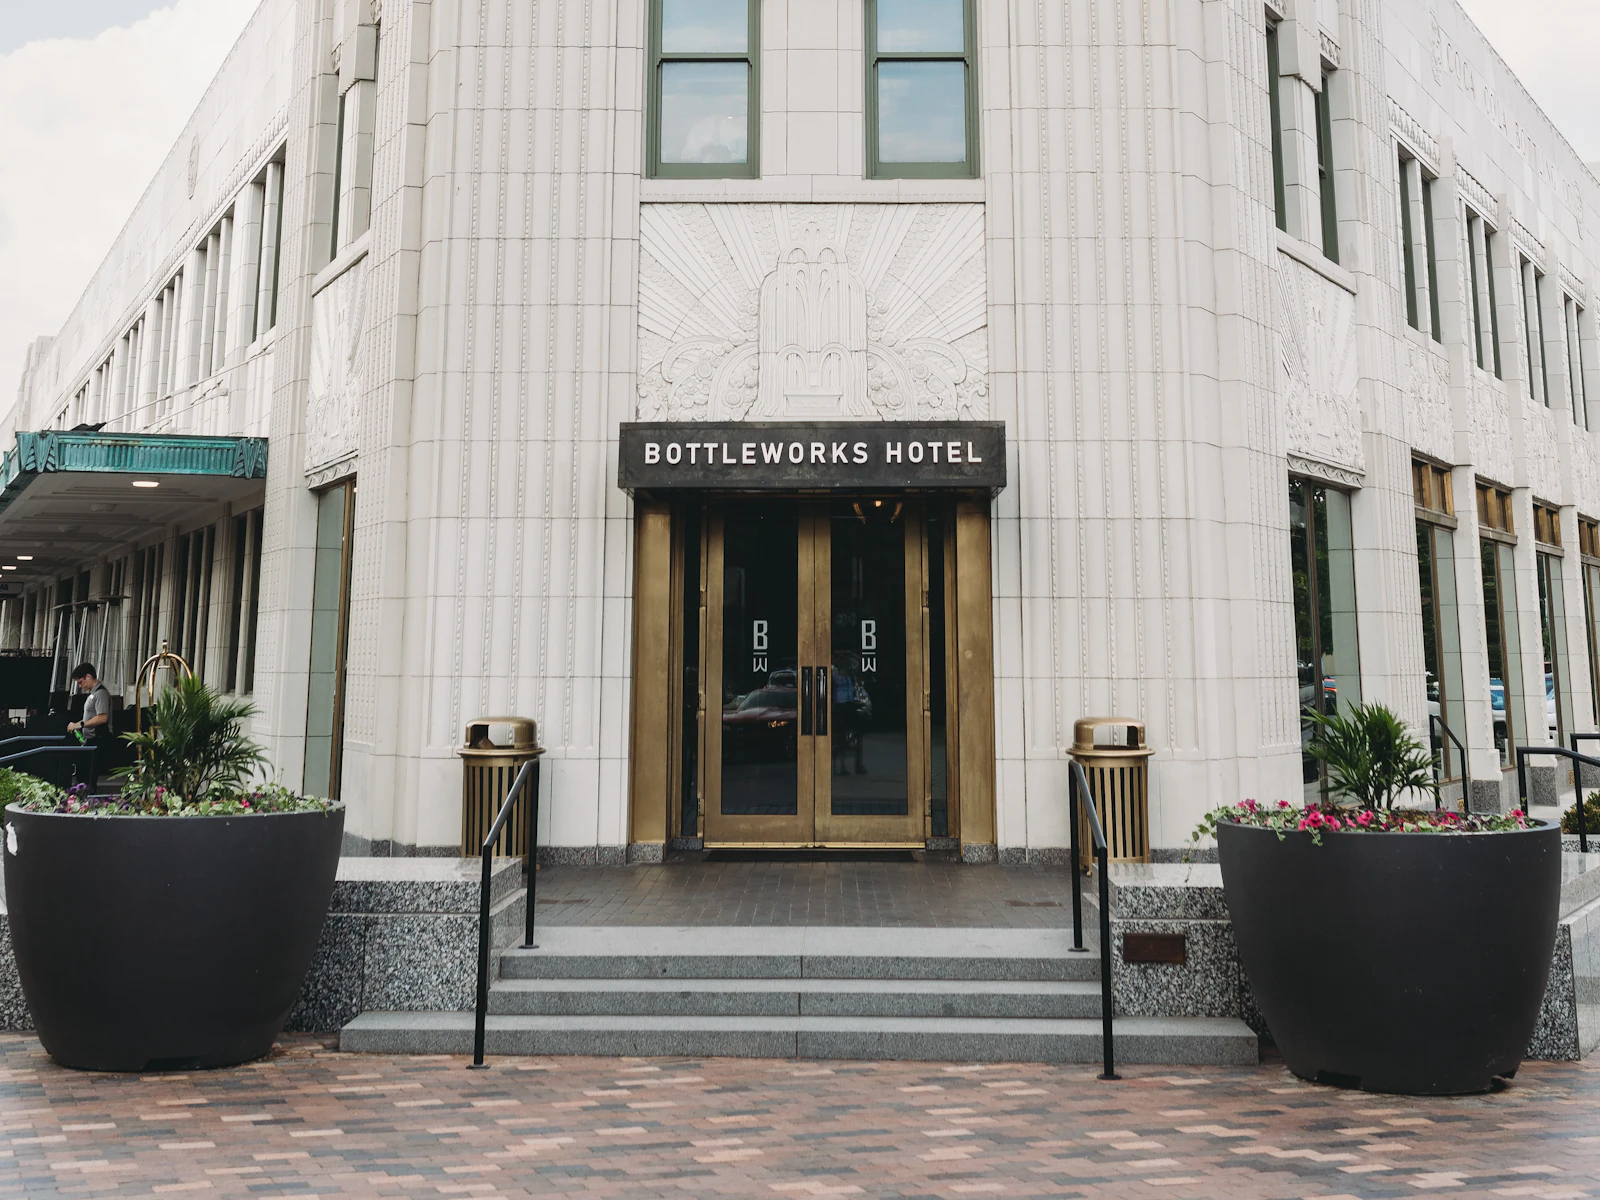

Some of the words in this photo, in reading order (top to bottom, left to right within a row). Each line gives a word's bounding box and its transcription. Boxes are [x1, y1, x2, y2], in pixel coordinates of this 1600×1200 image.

[644, 441, 869, 466] BOTTLEWORKS
[886, 440, 983, 464] HOTEL
[753, 620, 768, 650] B
[861, 620, 877, 650] B
